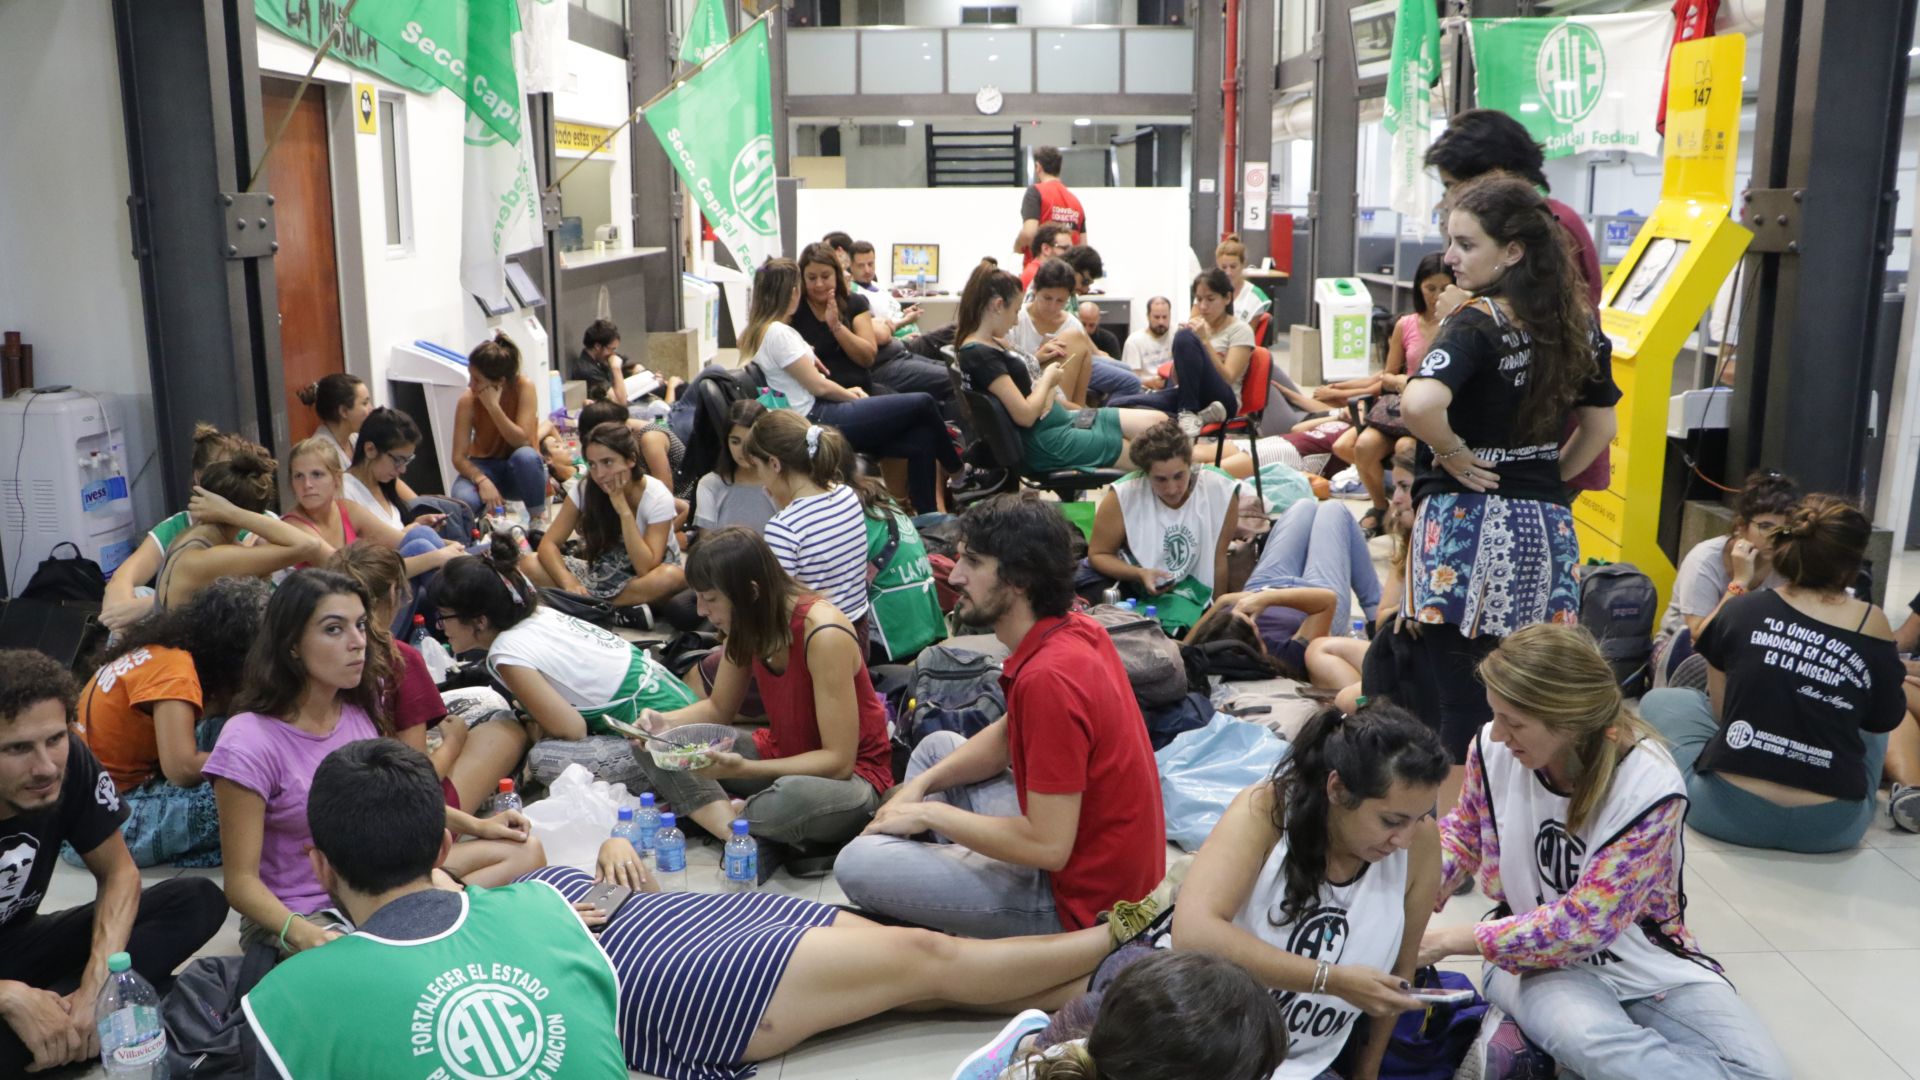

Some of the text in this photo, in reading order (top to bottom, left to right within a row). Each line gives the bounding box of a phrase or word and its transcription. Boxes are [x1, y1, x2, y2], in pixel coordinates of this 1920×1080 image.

[401, 21, 468, 82] Secc.
[1694, 87, 1712, 107] 147
[1592, 129, 1639, 145] Federal
[667, 127, 696, 176] Secc.
[697, 177, 738, 237] Capital
[1249, 206, 1259, 221] 5
[1750, 630, 1803, 656] ERRADICAR
[1803, 645, 1820, 661] EN
[1819, 651, 1839, 669] LAS
[1764, 650, 1779, 666] ES
[1780, 654, 1795, 672] LA
[1787, 622, 1825, 646] ÚNICO
[1825, 638, 1851, 659] QUE
[1848, 652, 1866, 673] HAY
[1751, 739, 1763, 750] DEL
[411, 963, 550, 1057] FORTALECER EL ESTADO
[447, 991, 535, 1076] ATE
[541, 1013, 567, 1073] NACION
